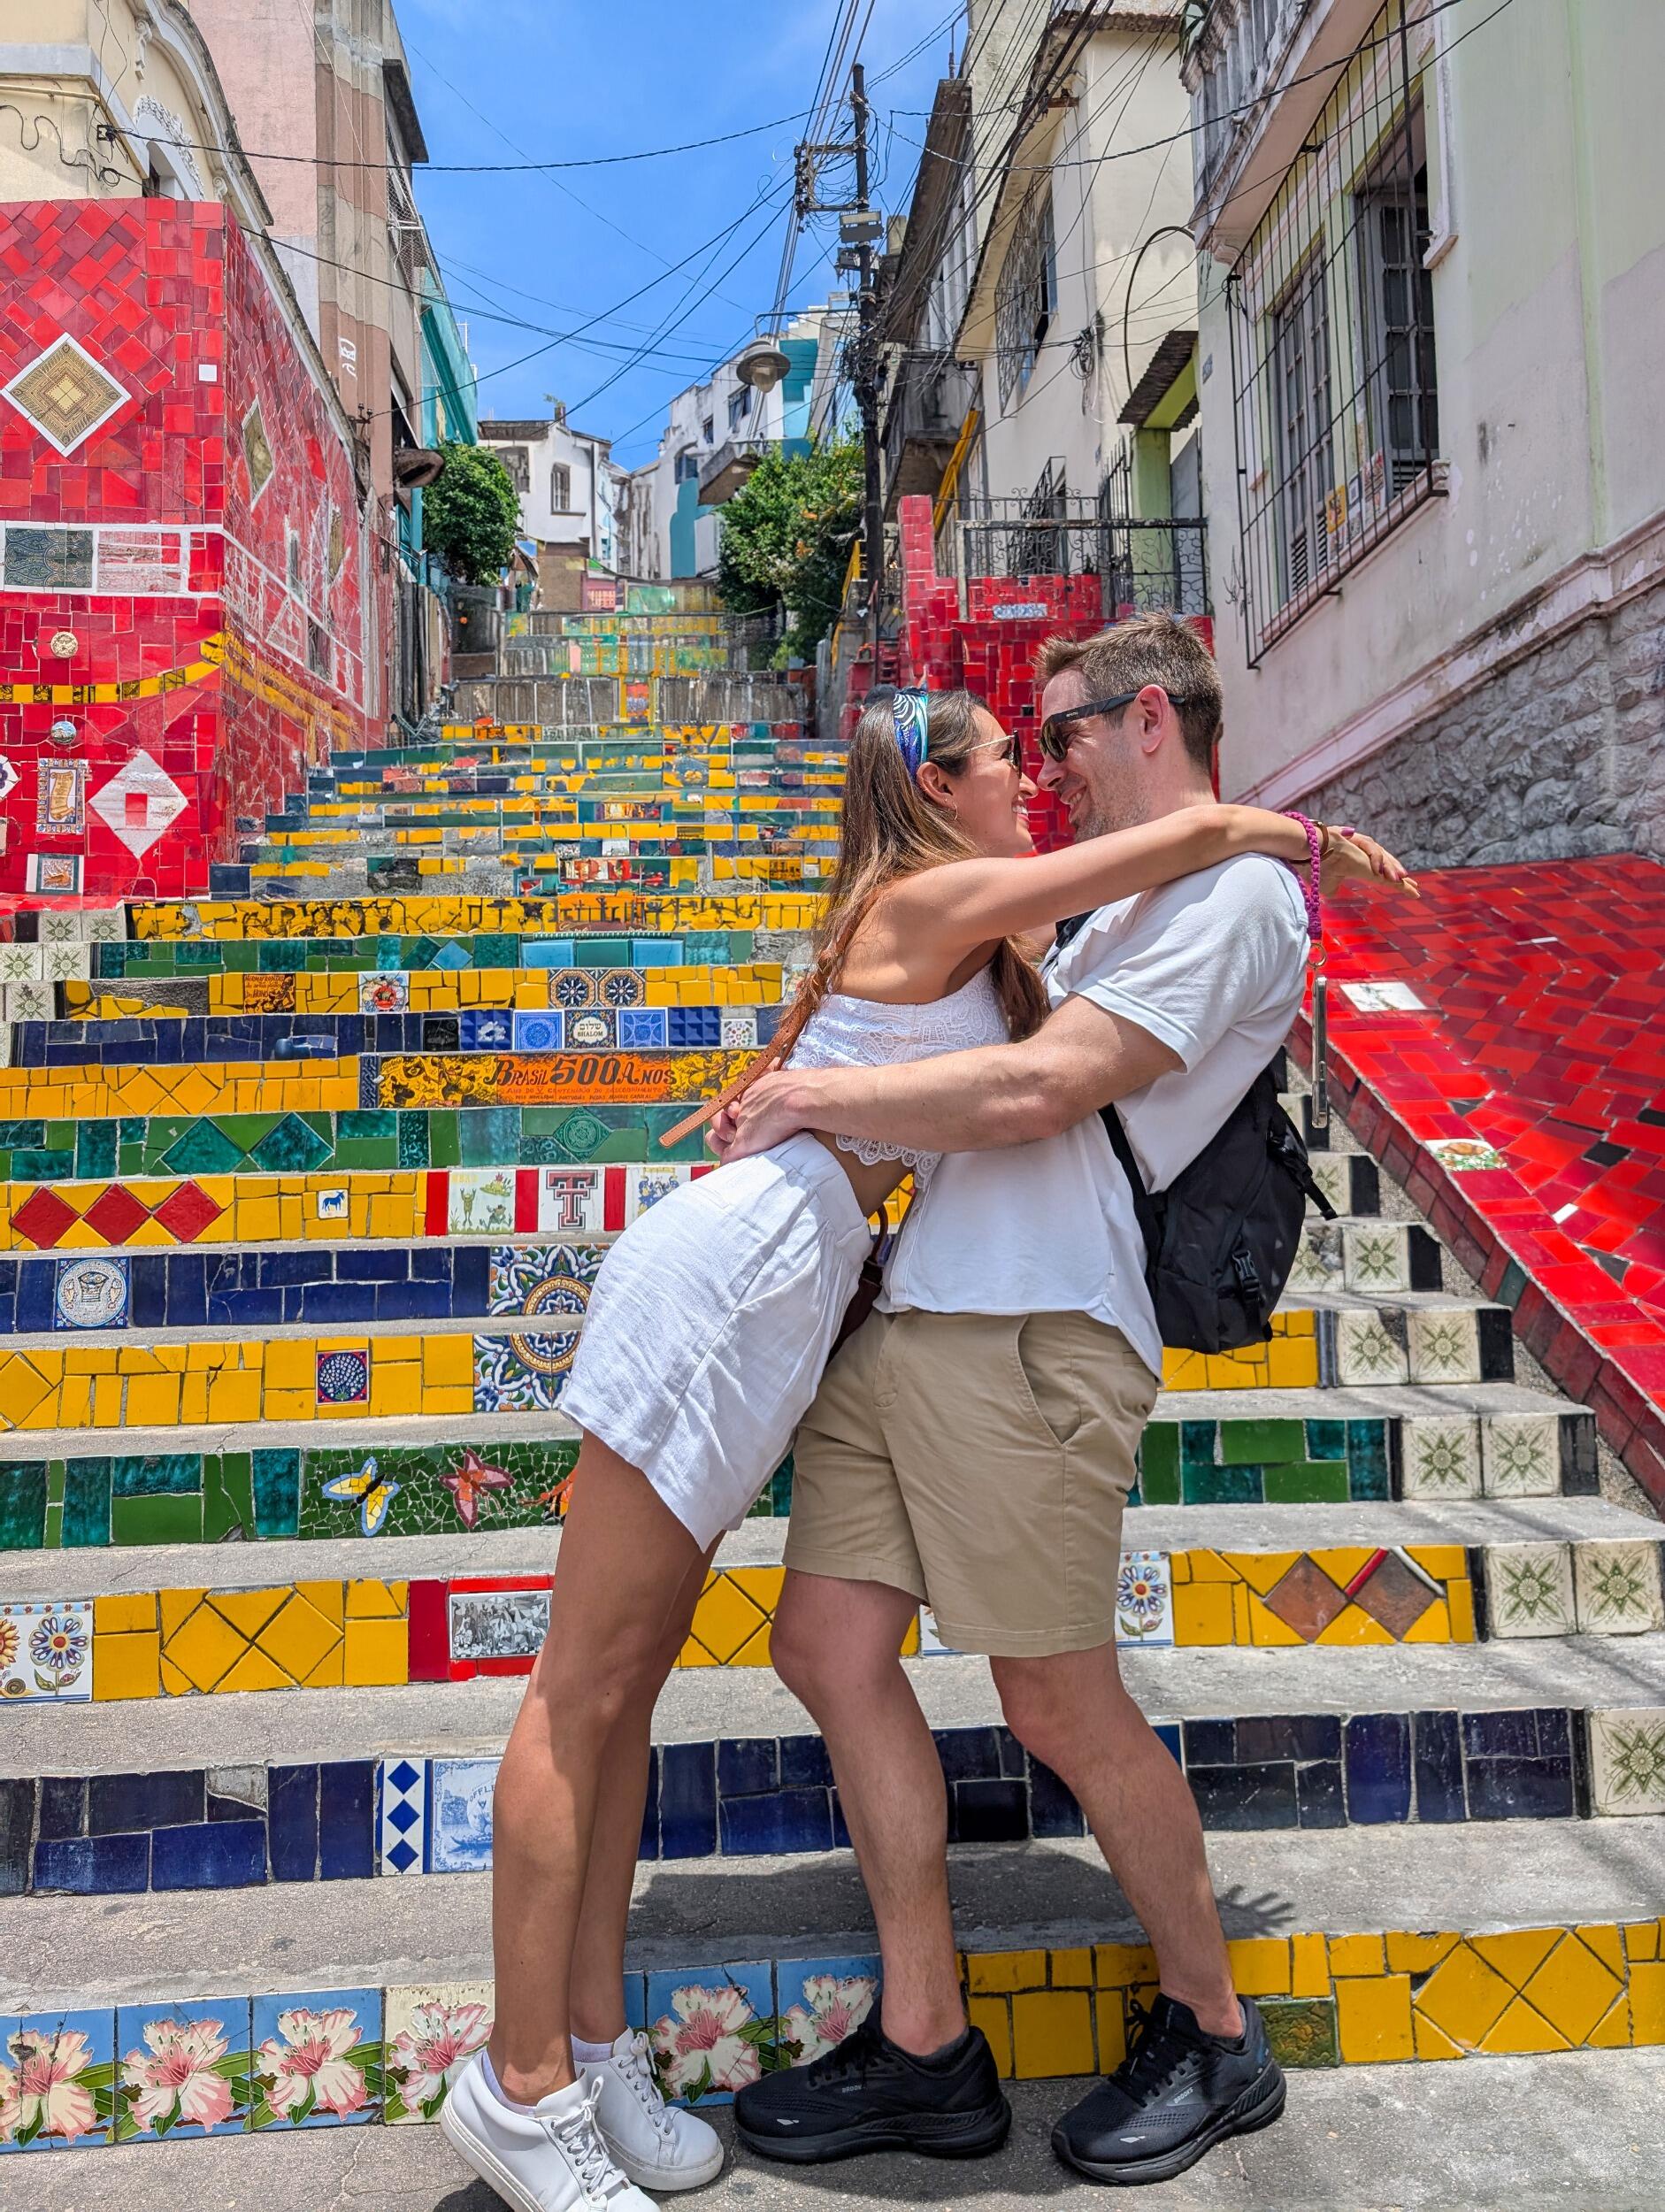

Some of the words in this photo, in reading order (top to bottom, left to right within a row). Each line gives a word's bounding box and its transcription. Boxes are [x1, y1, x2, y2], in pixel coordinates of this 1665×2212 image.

[579, 1020, 602, 1031] שלום
[550, 1057, 621, 1086] 500
[618, 1061, 677, 1086] ANOS
[1174, 2087, 1193, 2103] BROOKS
